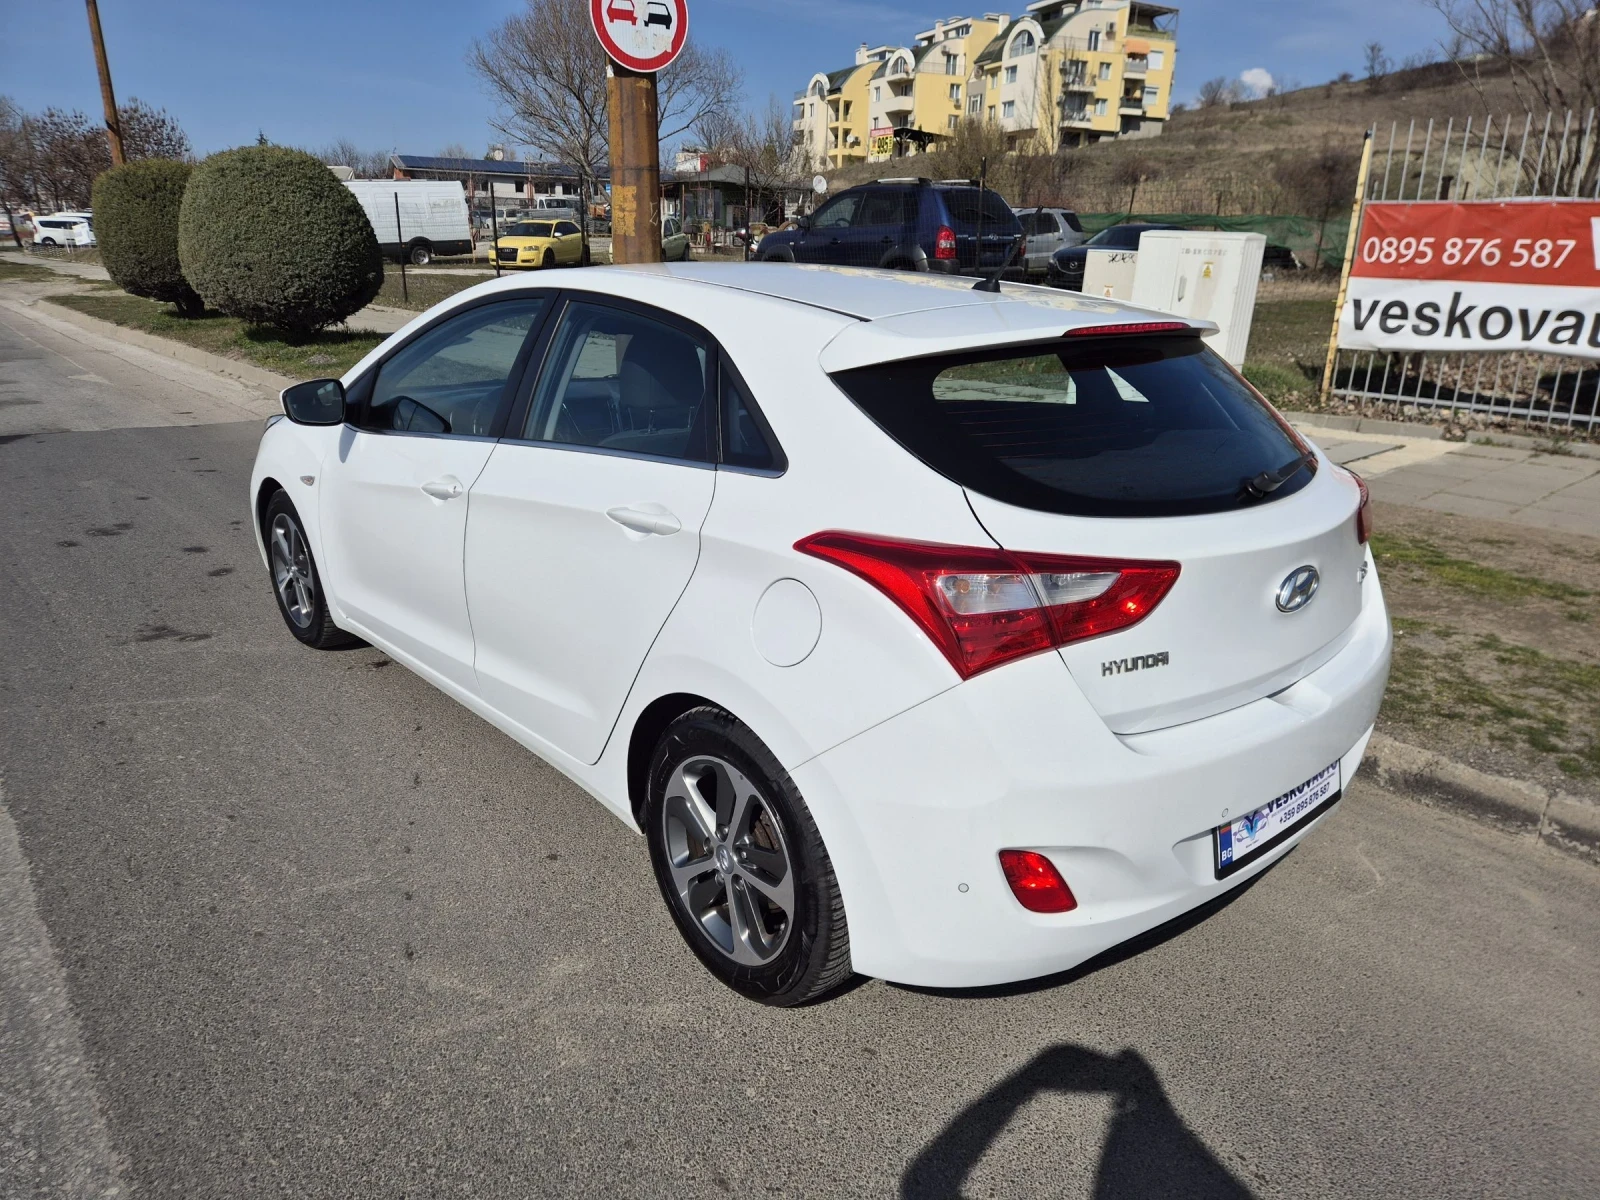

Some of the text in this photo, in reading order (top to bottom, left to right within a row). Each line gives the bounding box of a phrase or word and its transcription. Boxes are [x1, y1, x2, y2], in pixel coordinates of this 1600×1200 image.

[1363, 237, 1435, 264] 0895
[1441, 237, 1502, 266] 876
[1509, 239, 1577, 268] 587
[1101, 651, 1169, 677] HYUNDAI
[1279, 807, 1295, 824] +359
[1296, 798, 1308, 814] 895
[1309, 790, 1319, 805] 876
[1320, 781, 1330, 797] 587
[1222, 847, 1233, 861] BG
